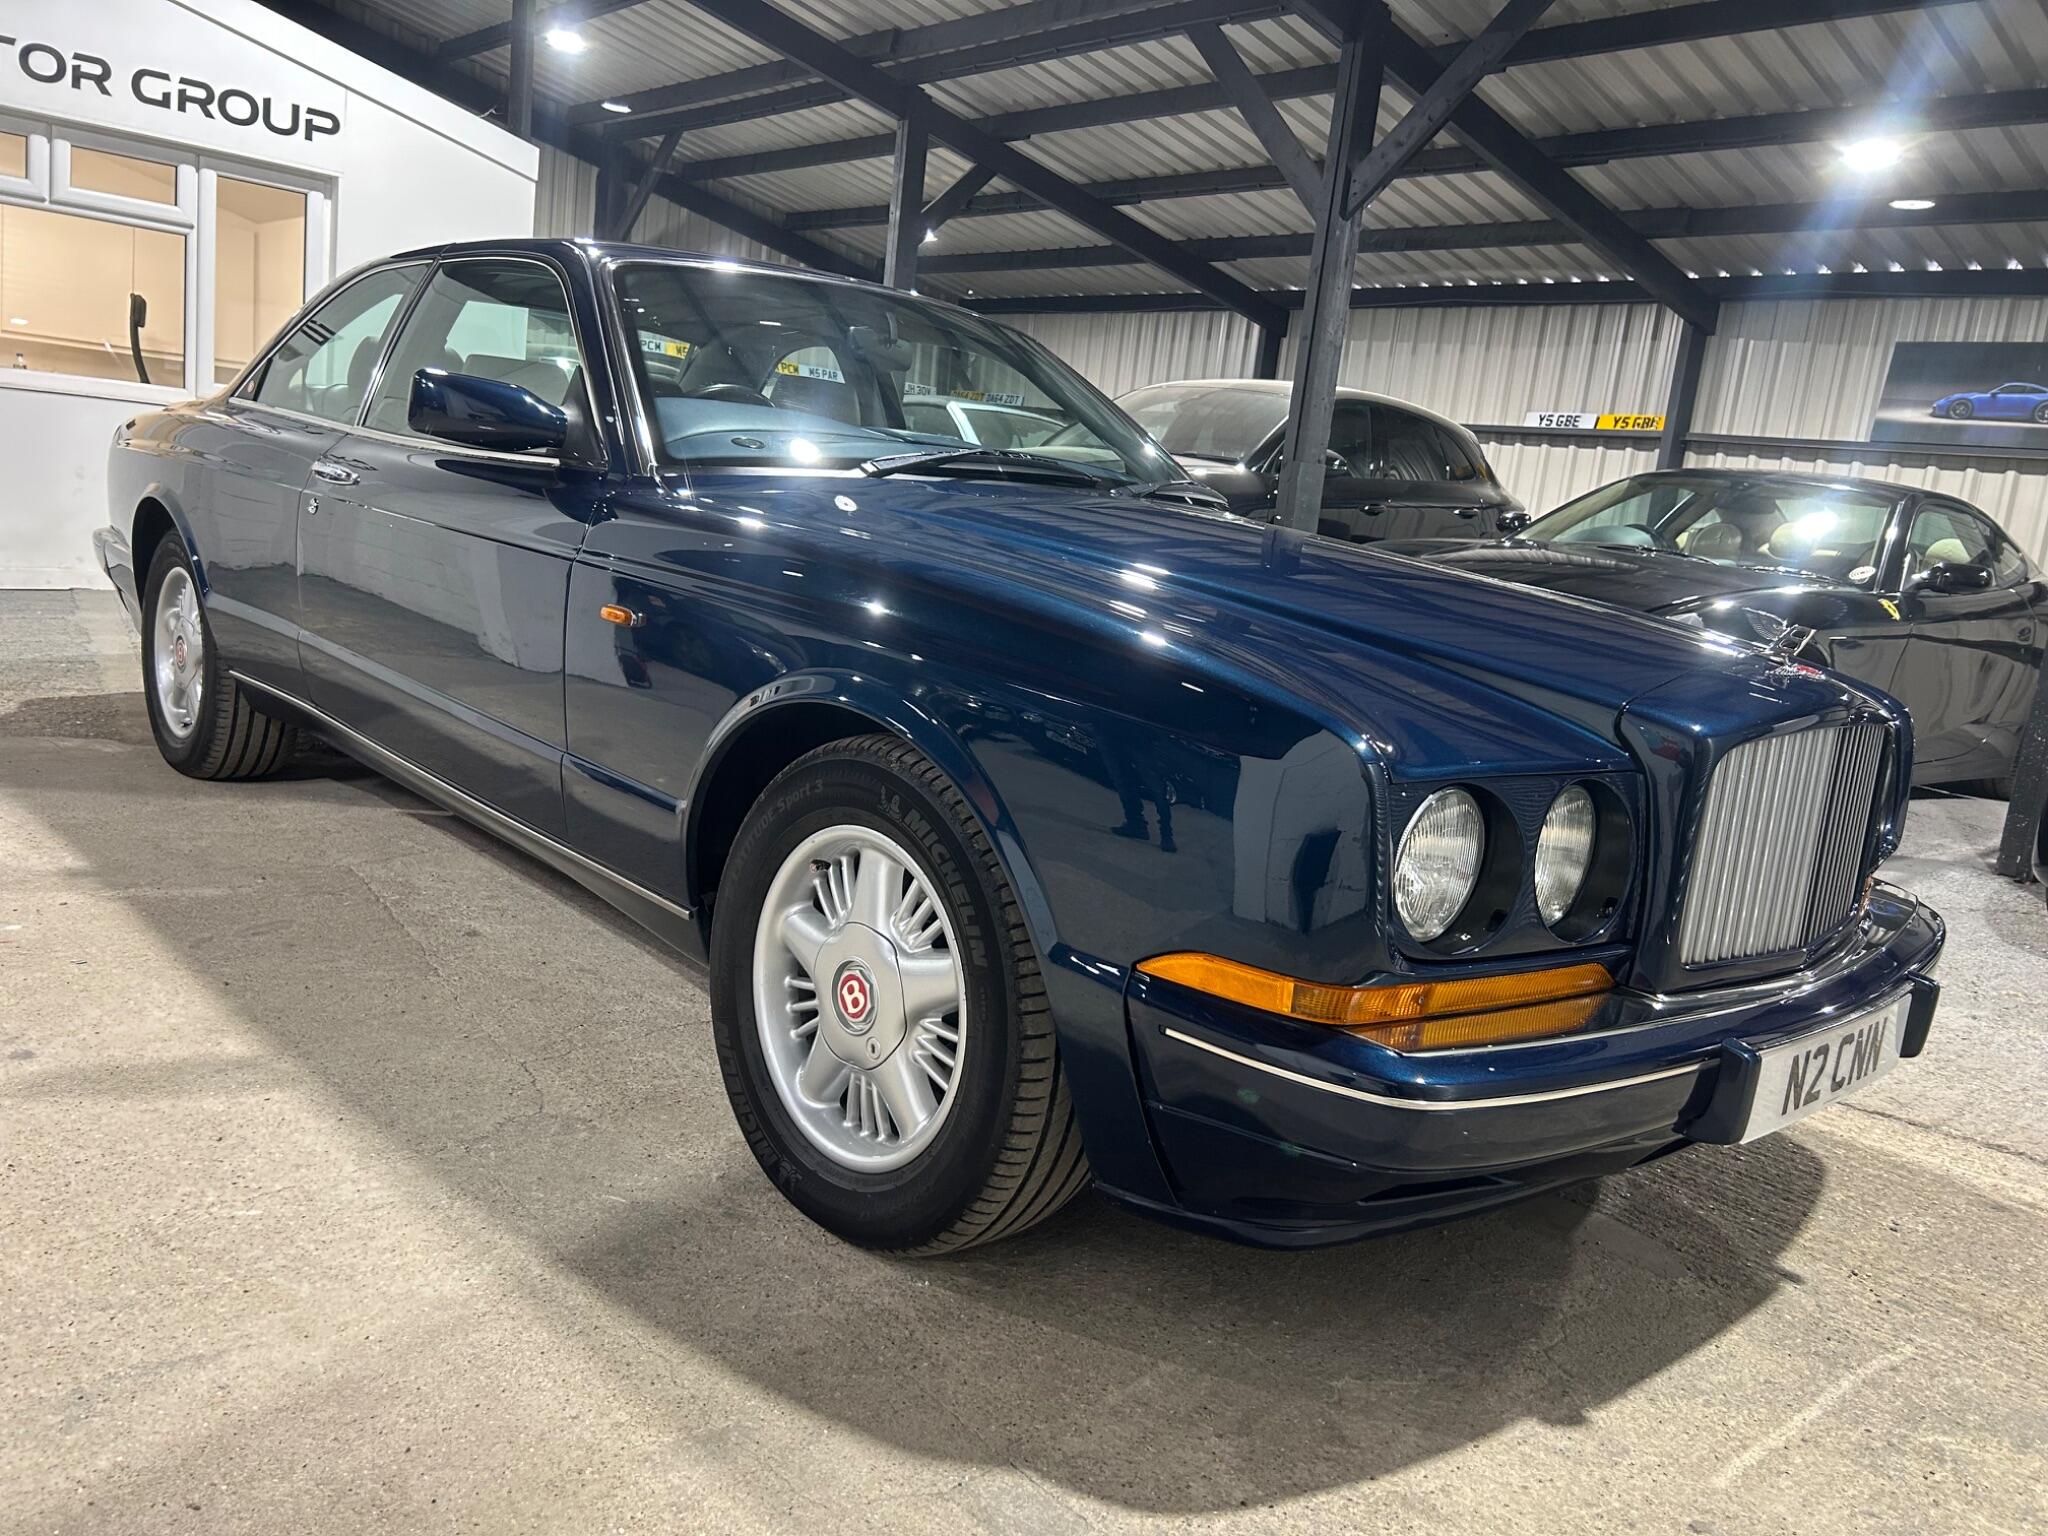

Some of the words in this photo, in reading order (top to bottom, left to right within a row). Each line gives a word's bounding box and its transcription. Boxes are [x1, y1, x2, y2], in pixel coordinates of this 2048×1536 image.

[131, 67, 341, 142] GROUP
[781, 361, 800, 375] PCM
[809, 366, 821, 378] M5
[822, 368, 838, 380] PAR
[1538, 413, 1553, 427] Y5
[1556, 414, 1581, 428] GBE
[1613, 416, 1630, 429] Y5
[775, 781, 812, 814] Sport
[814, 778, 824, 794] 3
[903, 808, 987, 968] MICHELIN
[842, 979, 866, 1014] B
[1781, 1043, 1829, 1116] N2
[1830, 1017, 1888, 1092] CNN
